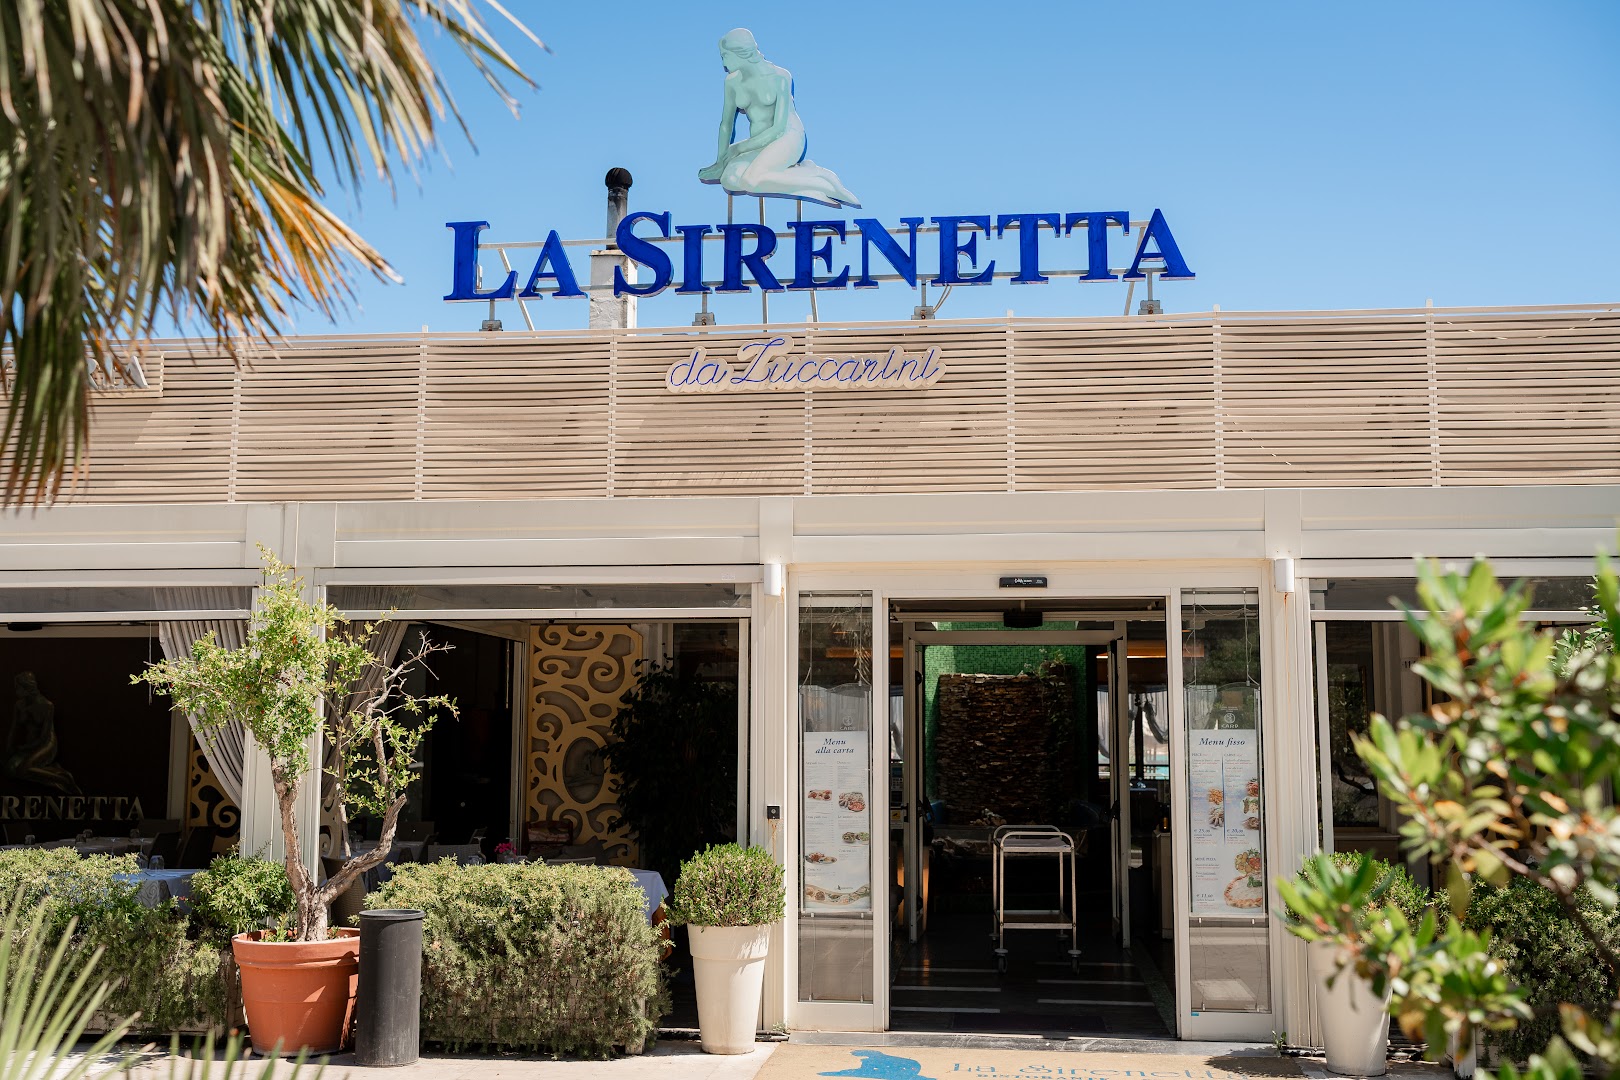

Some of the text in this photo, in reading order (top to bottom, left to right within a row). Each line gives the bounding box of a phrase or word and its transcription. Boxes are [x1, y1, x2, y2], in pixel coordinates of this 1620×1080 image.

[443, 207, 1197, 303] LA SIRENETTA
[669, 349, 729, 387] da
[815, 746, 831, 754] alla
[822, 738, 847, 746] Menu
[1198, 737, 1246, 748] Menu fisso
[0, 795, 145, 821] RENETTA
